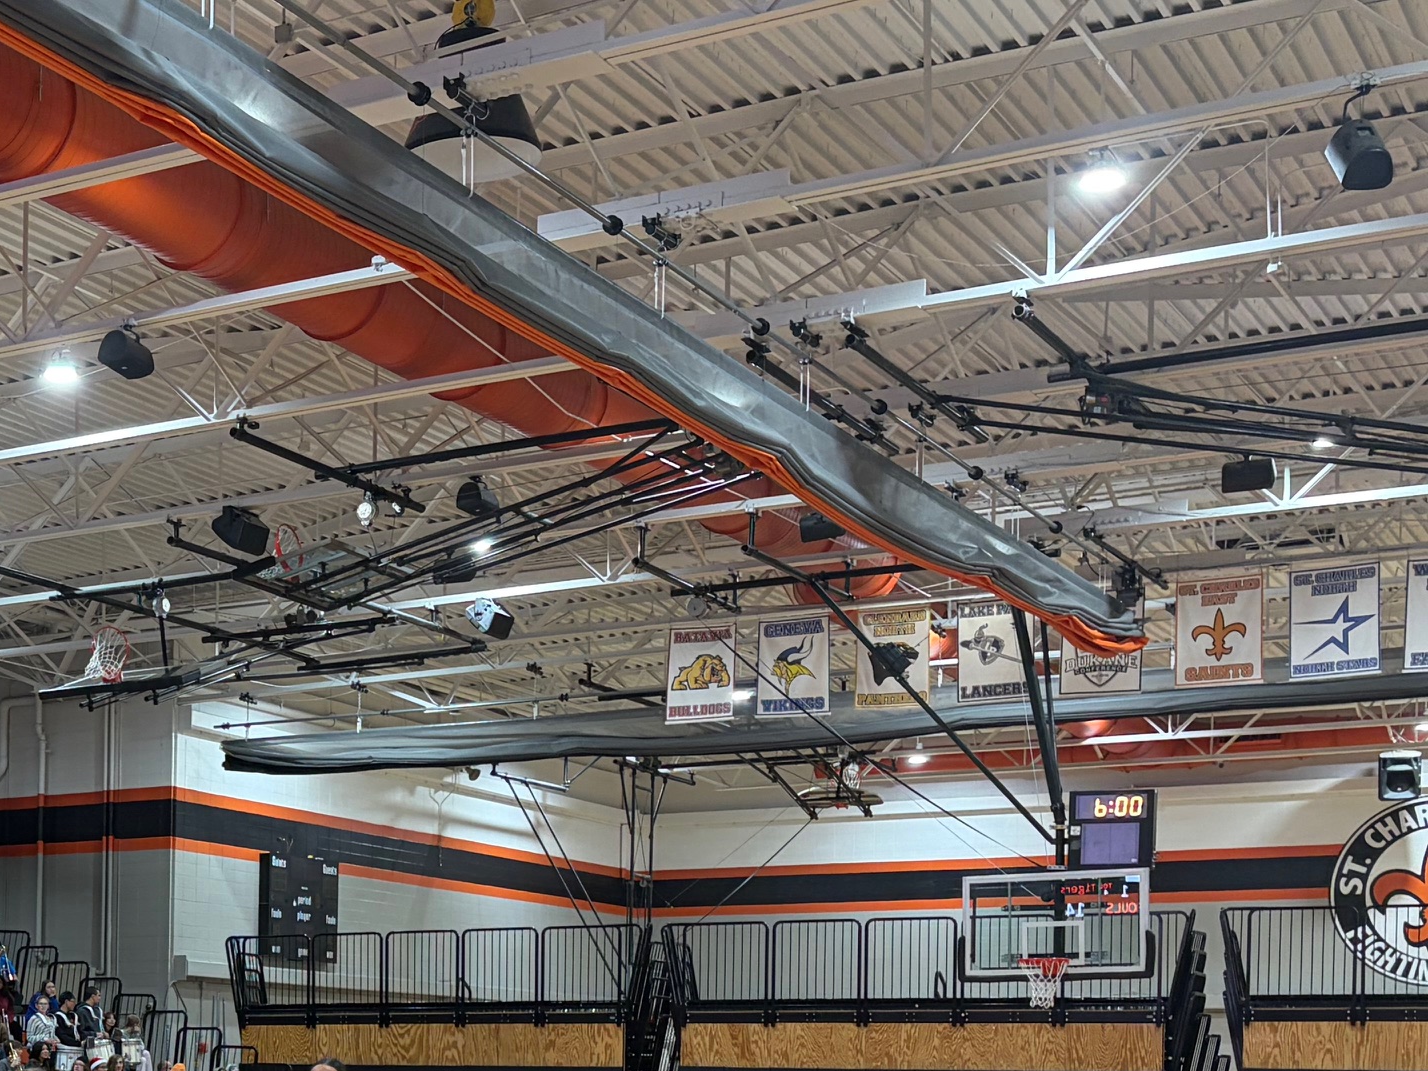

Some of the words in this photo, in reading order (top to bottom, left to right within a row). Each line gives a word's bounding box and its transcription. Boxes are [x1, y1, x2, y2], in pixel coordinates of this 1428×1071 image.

[959, 604, 995, 618] LAKE
[764, 619, 824, 638] GENEVA
[1094, 795, 1143, 818] 6:00
[1339, 855, 1372, 896] ST.
